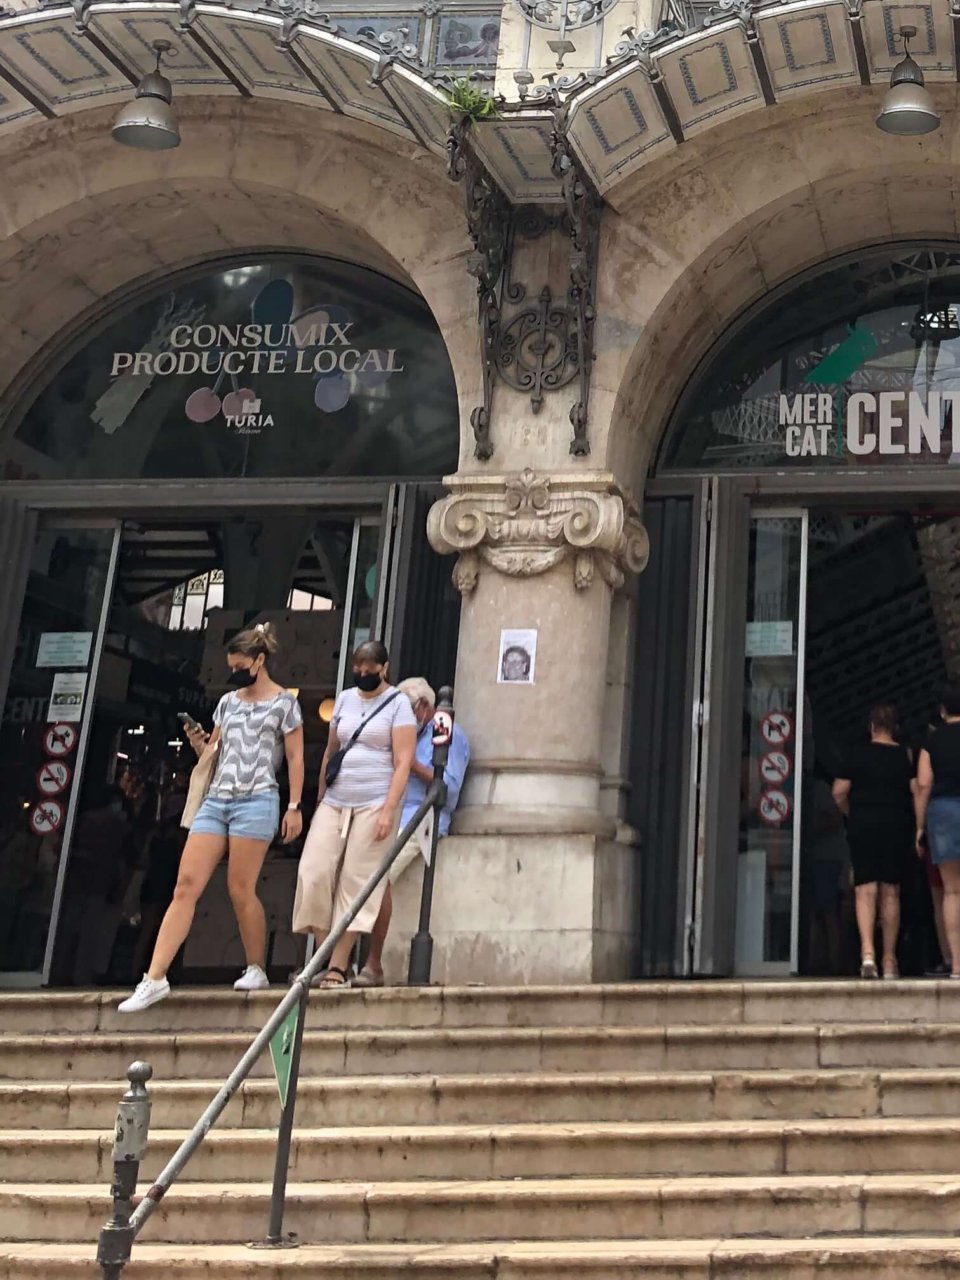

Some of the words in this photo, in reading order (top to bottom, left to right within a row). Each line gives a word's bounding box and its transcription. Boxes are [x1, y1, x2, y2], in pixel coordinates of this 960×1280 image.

[170, 322, 354, 348] CONSUMIX
[110, 349, 288, 376] PRODUCTE
[294, 349, 404, 374] LOCAL
[225, 414, 275, 428] TURIA
[779, 393, 833, 425] MER
[785, 425, 832, 457] CAT
